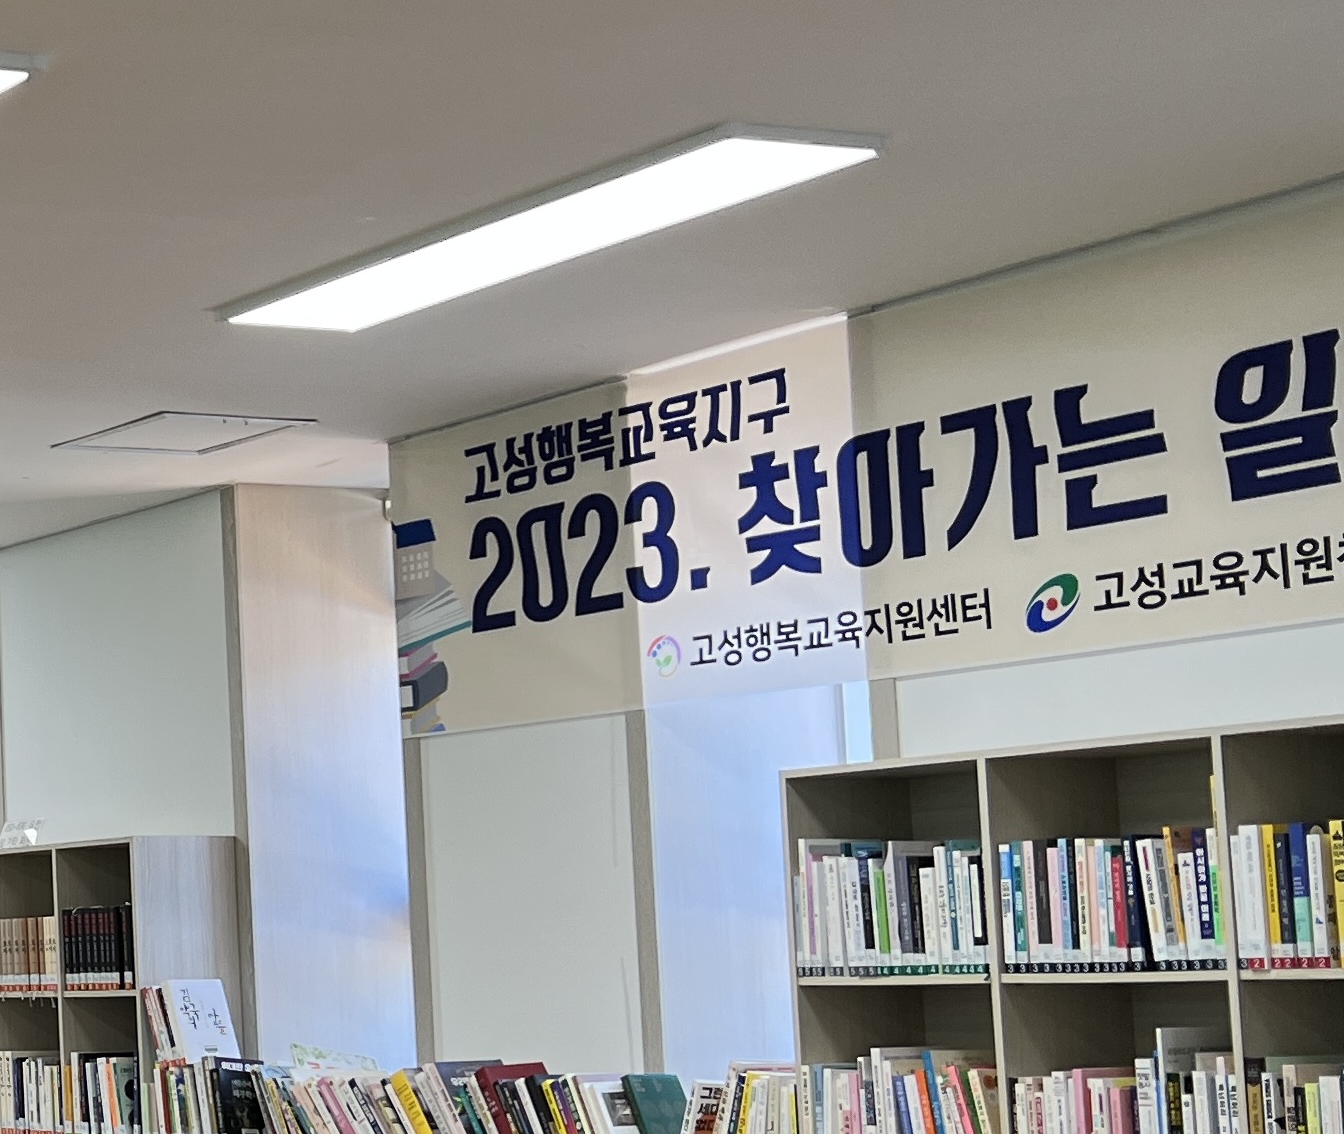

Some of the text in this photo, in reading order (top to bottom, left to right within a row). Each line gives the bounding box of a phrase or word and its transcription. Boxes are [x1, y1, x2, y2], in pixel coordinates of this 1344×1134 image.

[464, 367, 790, 505] 고성행복교육지구
[470, 327, 1342, 634] 2023. 찾아가는 일
[690, 589, 994, 668] 고성행복교육지원센터
